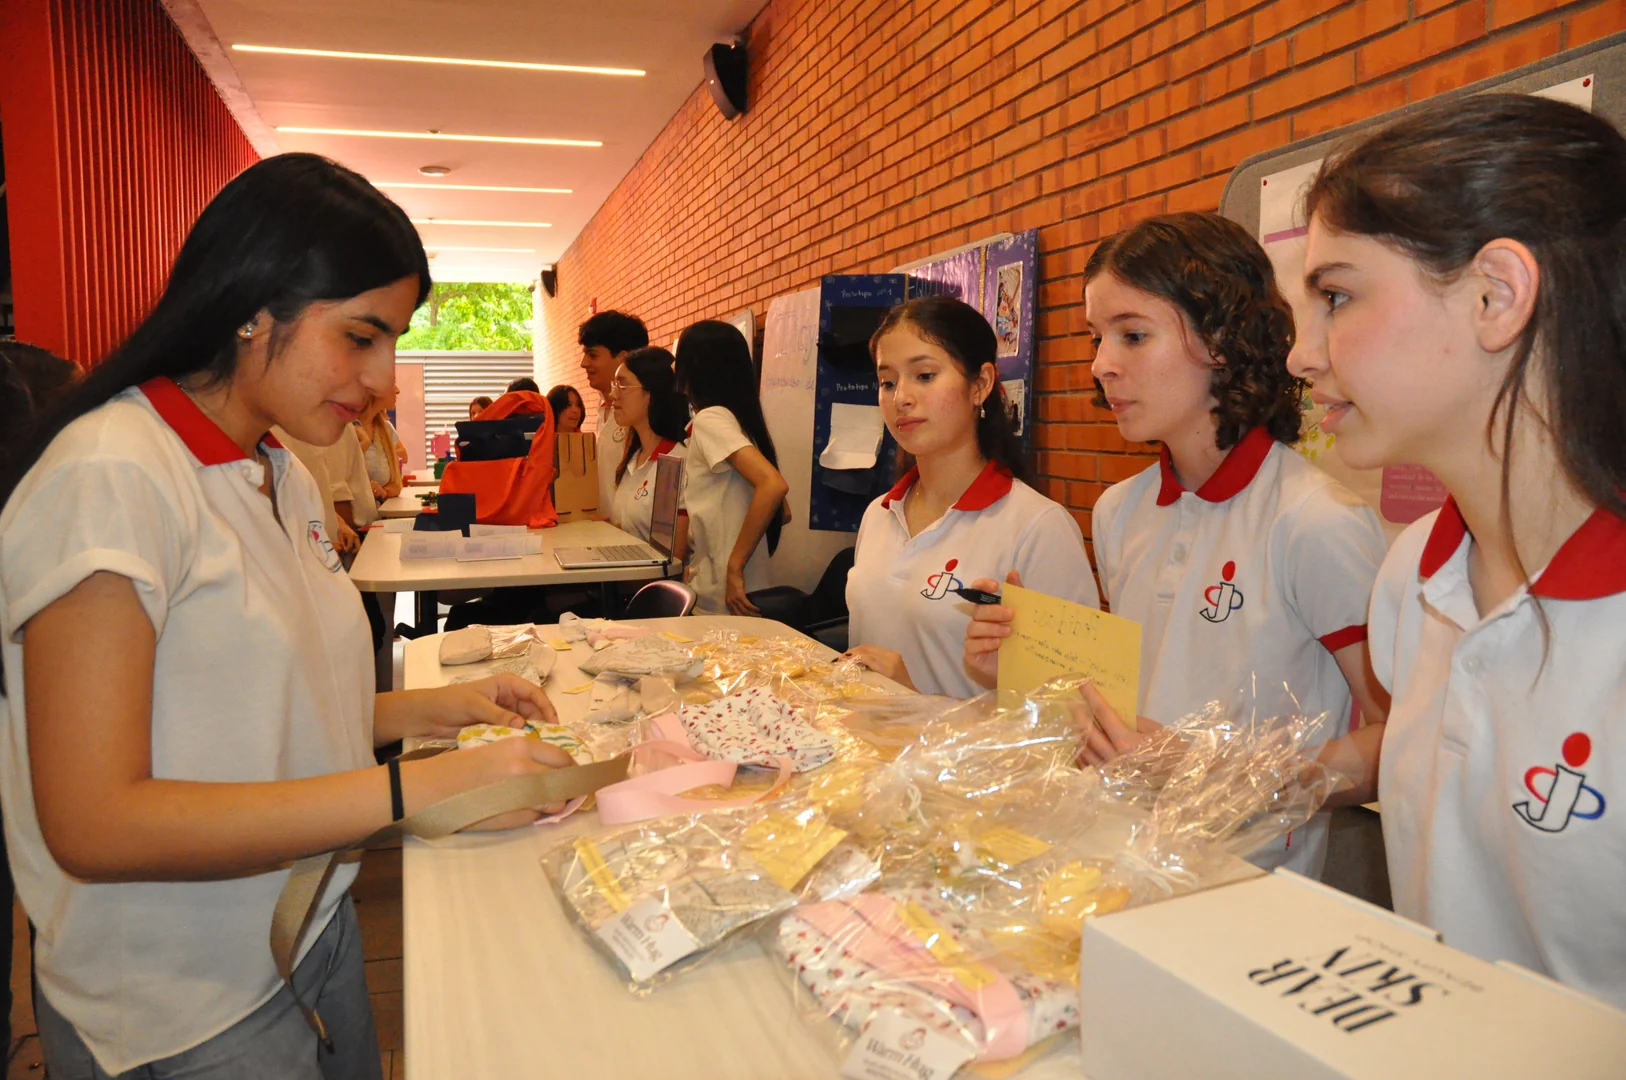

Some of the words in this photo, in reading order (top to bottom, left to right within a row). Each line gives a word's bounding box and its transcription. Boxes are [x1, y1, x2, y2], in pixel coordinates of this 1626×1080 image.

[835, 382, 869, 392] Prototipo
[621, 912, 645, 941] Warm
[1306, 945, 1451, 1008] SKIN
[1248, 957, 1397, 1033] DEAR
[866, 1038, 905, 1063] Warm
